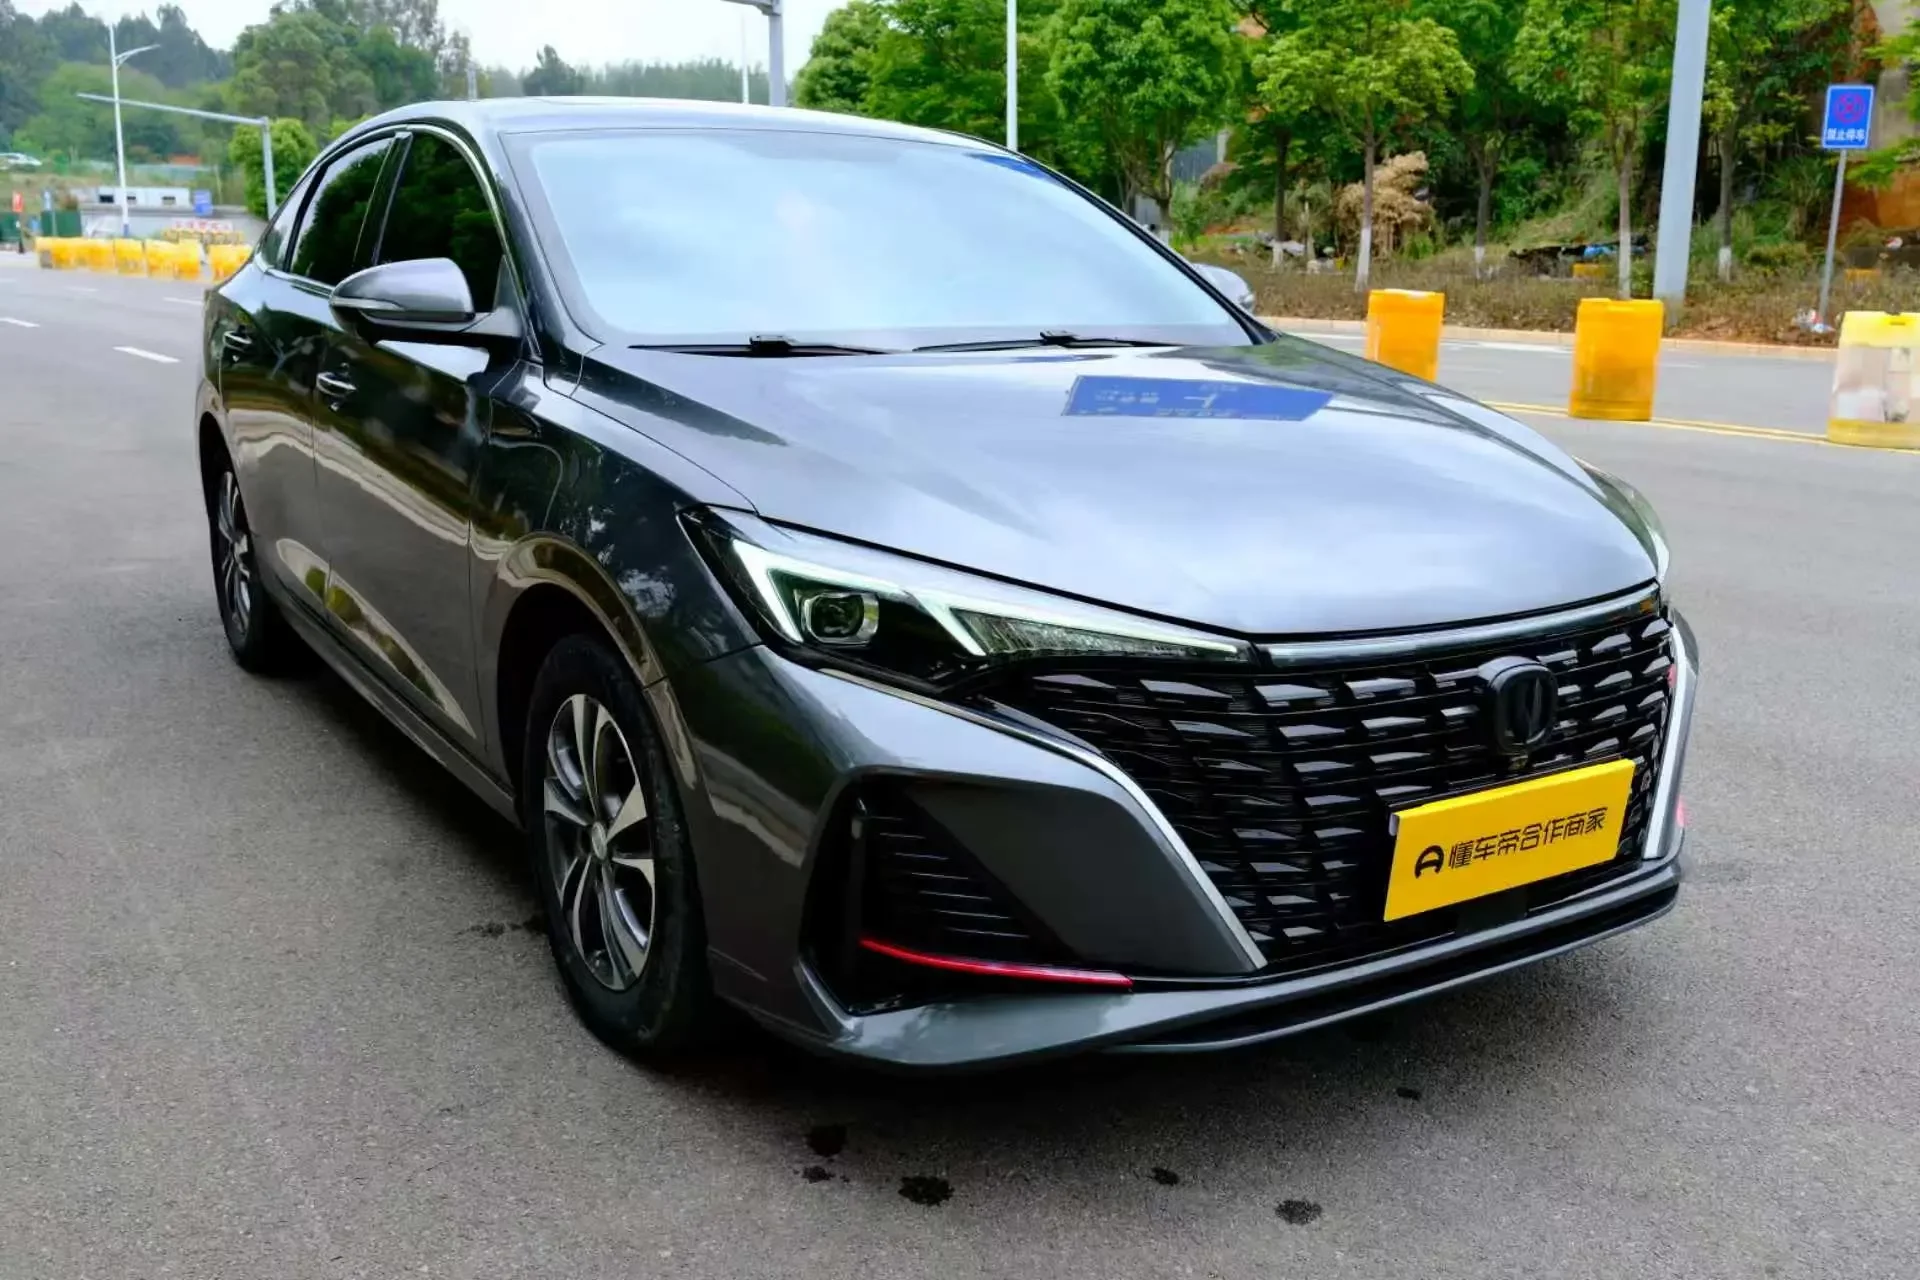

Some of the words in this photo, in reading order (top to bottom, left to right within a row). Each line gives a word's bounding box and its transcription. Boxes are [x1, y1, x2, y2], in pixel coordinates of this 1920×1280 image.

[1448, 806, 1608, 869] 懂车帝合作商家
